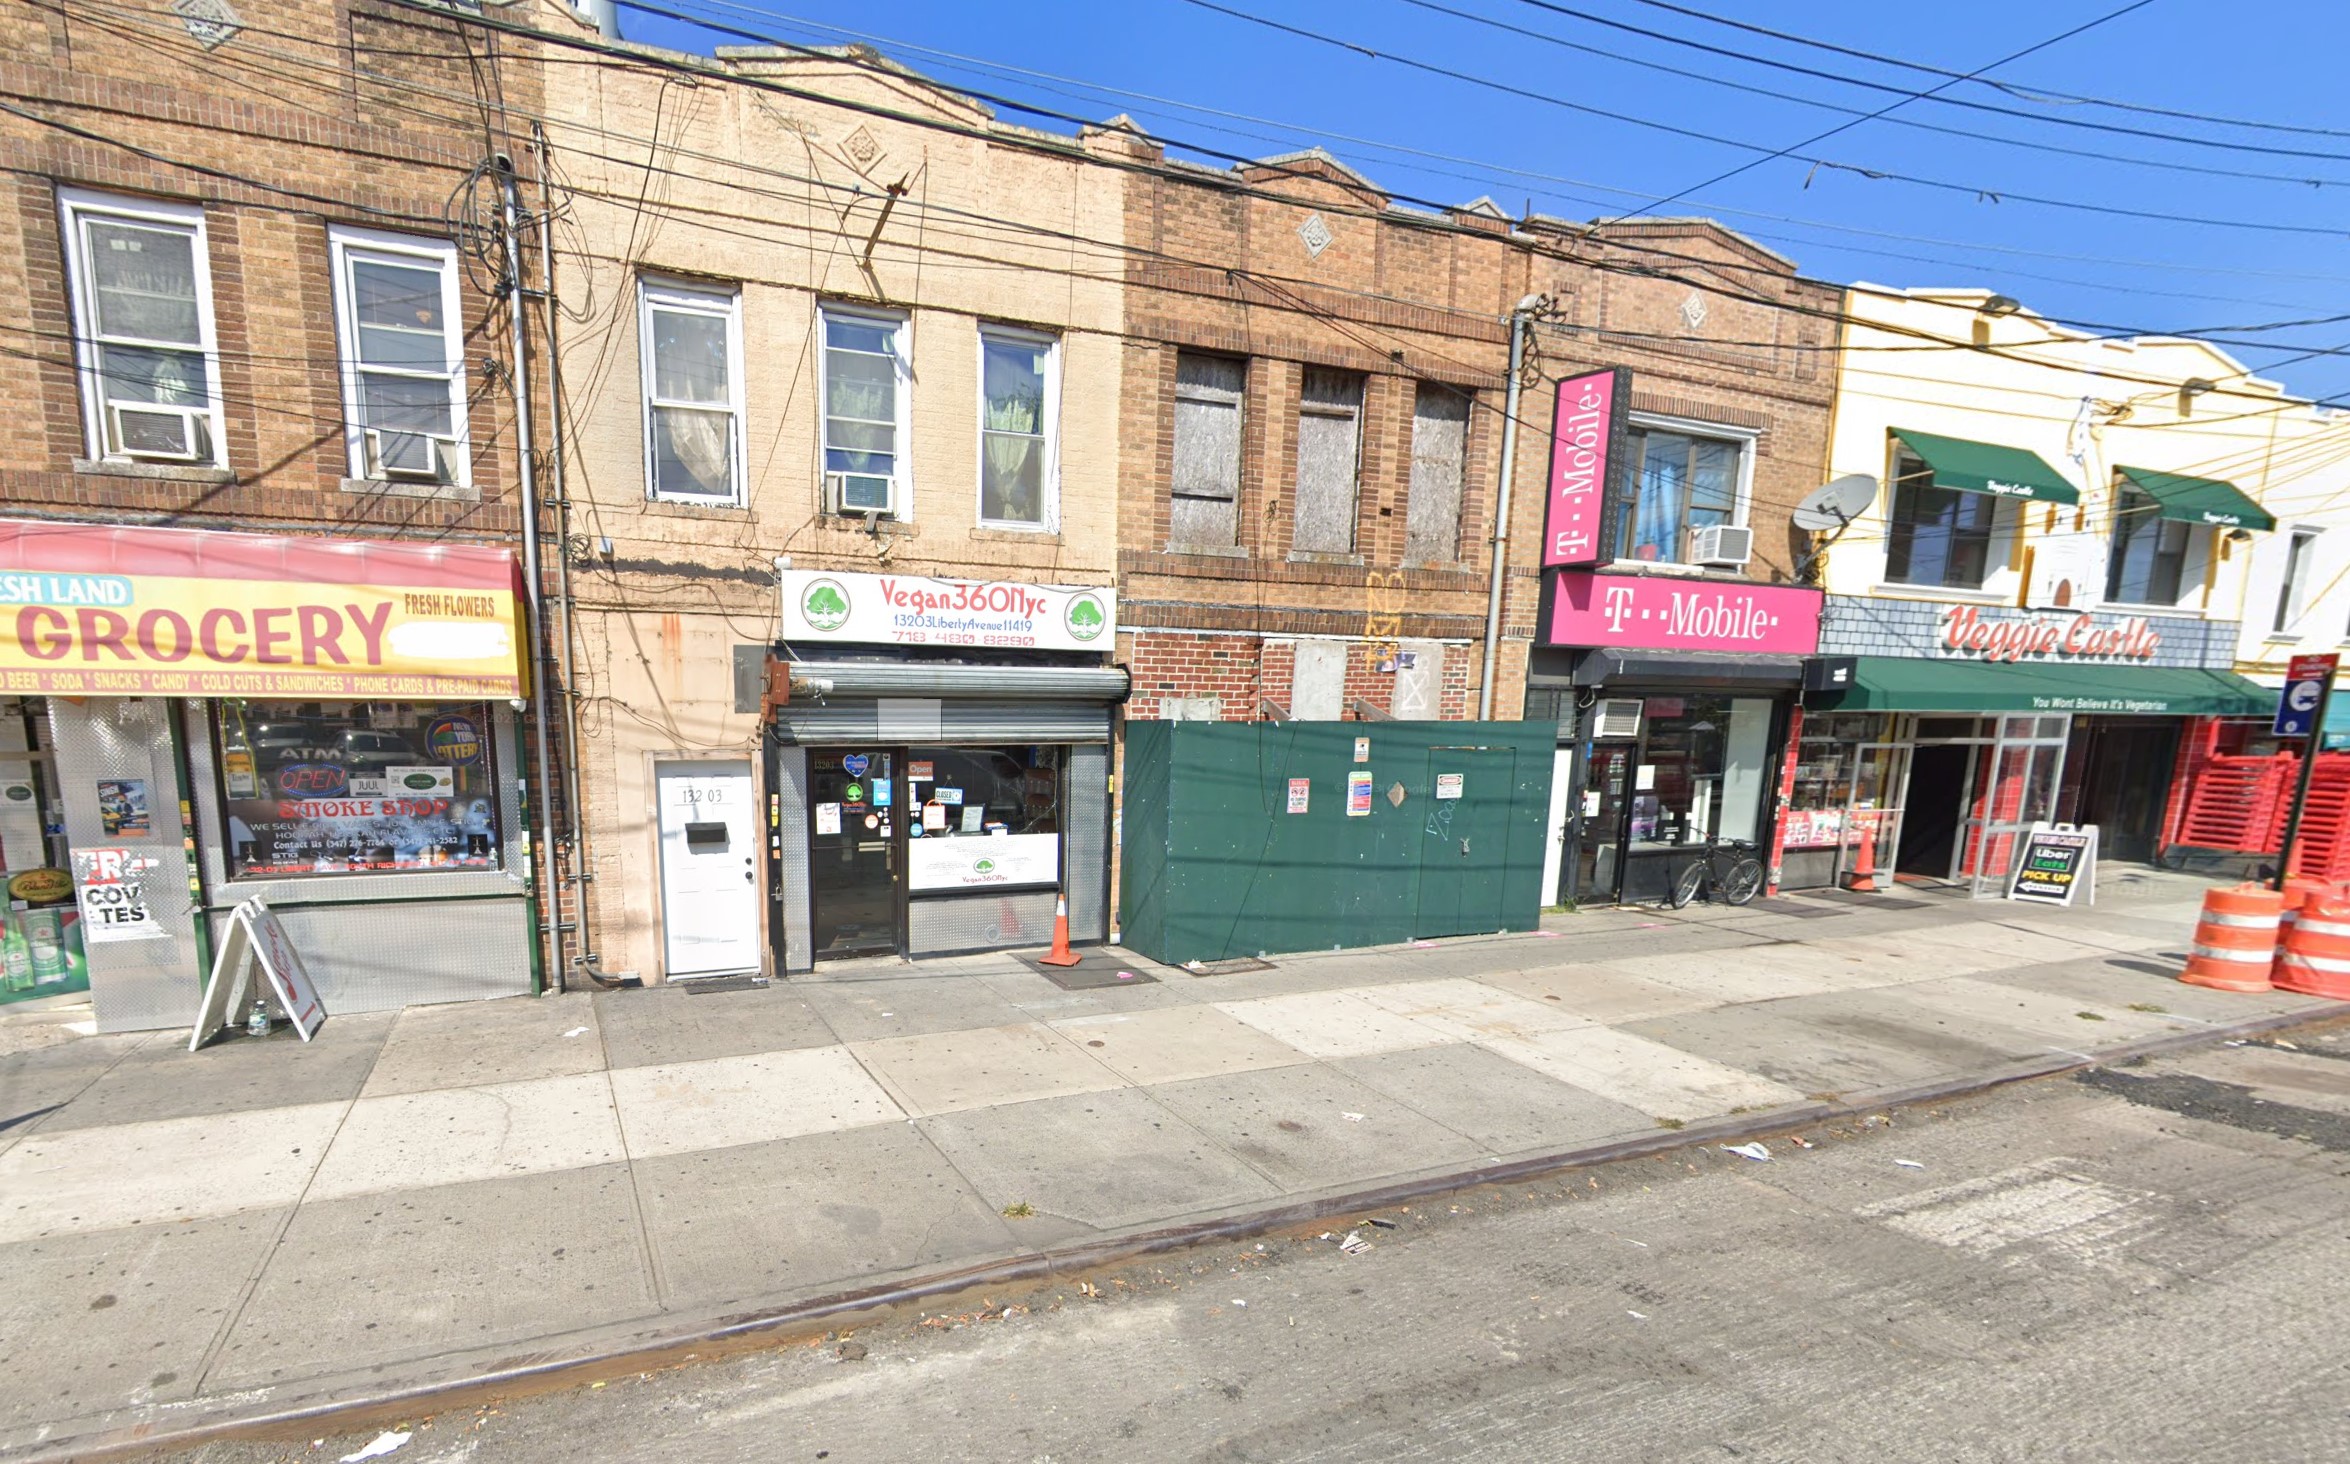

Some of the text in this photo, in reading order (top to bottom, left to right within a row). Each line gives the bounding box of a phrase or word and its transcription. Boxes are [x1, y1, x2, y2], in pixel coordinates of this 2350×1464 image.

[51, 576, 127, 604] LAND
[404, 593, 495, 618] FRESH FLOWERS
[16, 602, 394, 666] GROCERY
[1948, 604, 2161, 662] Veggie Castle
[7, 672, 40, 689] BEER
[50, 672, 84, 690] SODA
[93, 672, 141, 689] SNACKS
[152, 673, 190, 690] CANDY
[201, 674, 231, 690] COLD
[233, 675, 263, 690] CUTS
[265, 676, 274, 690] &
[276, 676, 344, 692] SANDWICHES
[354, 677, 388, 693] PHONE
[390, 677, 424, 694] CARDS
[426, 678, 435, 693] &
[436, 678, 479, 694] PRE-PAID
[481, 679, 513, 695] CARDS
[2033, 697, 2050, 708] You
[453, 722, 471, 731] NEW
[280, 747, 341, 759] ATM
[434, 742, 479, 760] LOTTERY
[909, 764, 932, 775] Open
[280, 769, 346, 790] OPEN
[358, 780, 379, 790] JUUL
[278, 800, 374, 819] SMOKE
[249, 823, 270, 831] WE
[272, 822, 298, 831] SELL
[273, 841, 308, 849] Contact
[326, 840, 347, 849] (347)
[2036, 848, 2071, 860] Uber
[2034, 858, 2066, 869] Eats
[2022, 870, 2072, 883] PICK UP
[99, 907, 145, 924] TES
